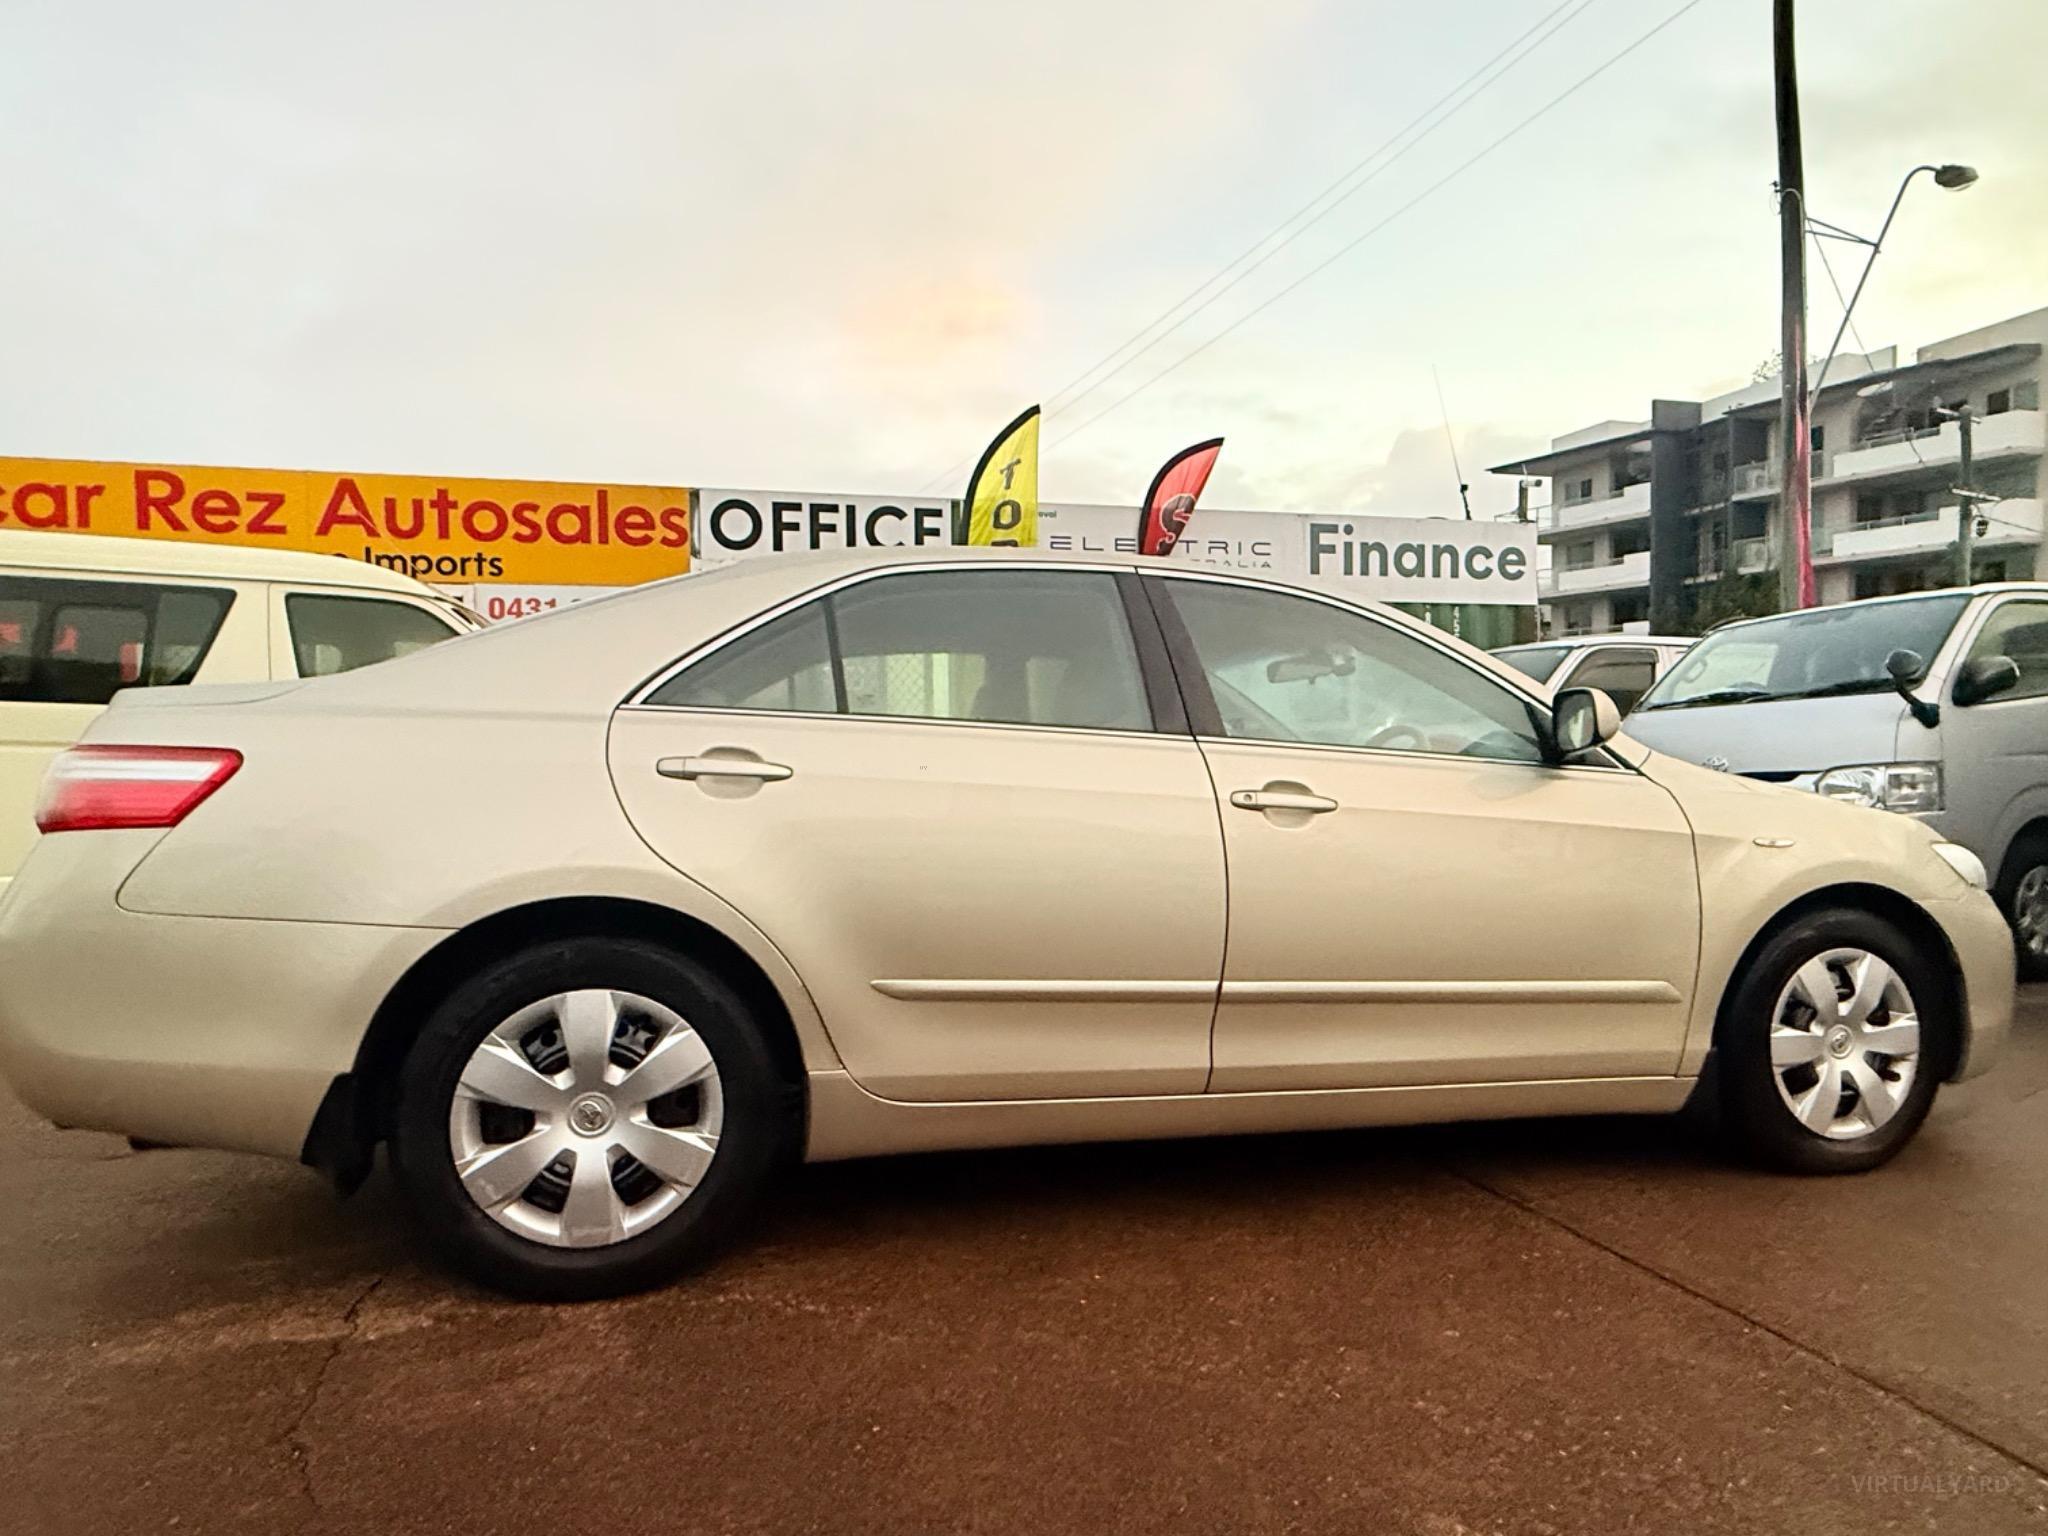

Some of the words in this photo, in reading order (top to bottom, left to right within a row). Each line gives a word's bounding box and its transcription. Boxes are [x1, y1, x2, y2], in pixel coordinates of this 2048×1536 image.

[0, 482, 105, 528] ar
[134, 469, 287, 535] Rez
[315, 478, 689, 547] Autosales
[364, 546, 504, 580] Imports
[1050, 535, 1271, 556] ELETRIC
[1309, 523, 1526, 581] Finance
